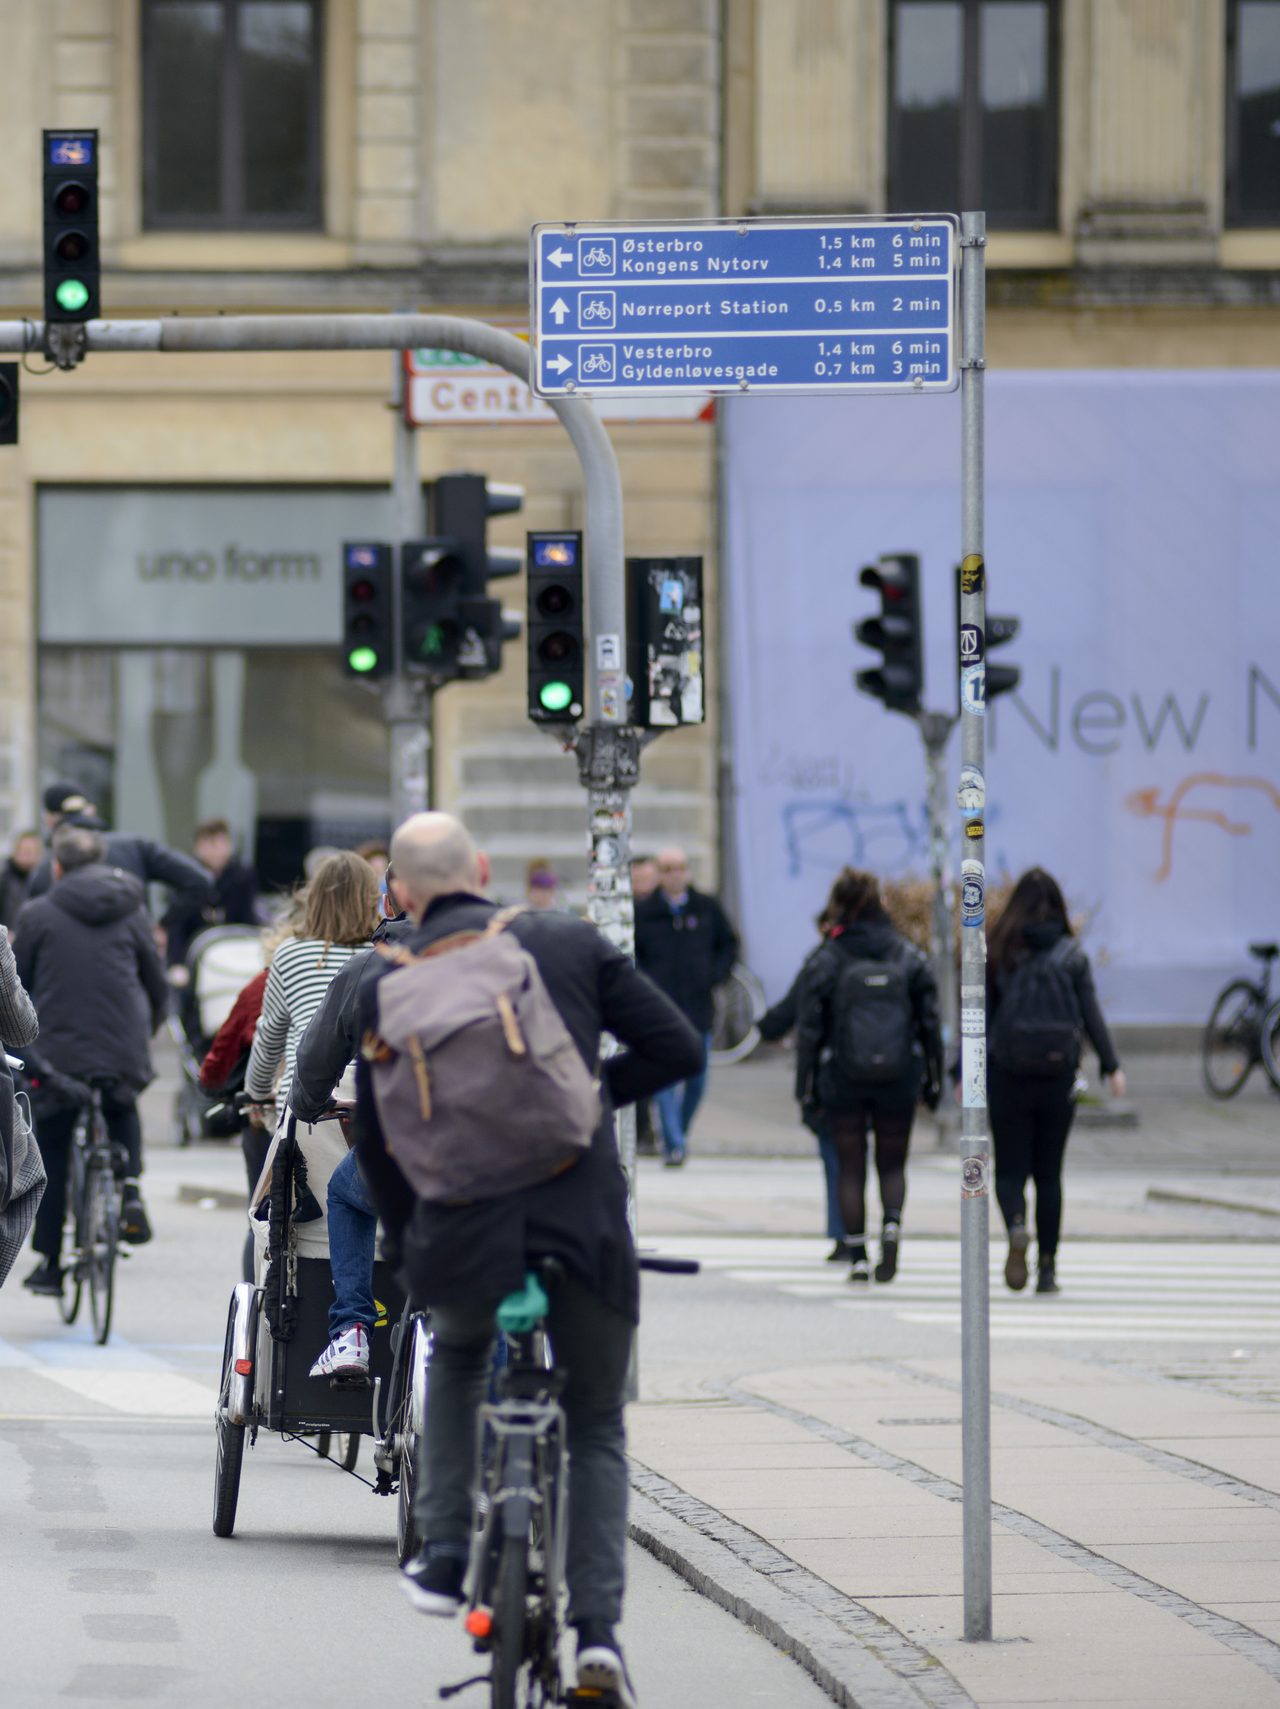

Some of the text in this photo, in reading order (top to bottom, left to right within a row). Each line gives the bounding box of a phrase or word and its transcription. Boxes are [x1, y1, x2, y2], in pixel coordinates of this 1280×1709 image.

[622, 238, 704, 254] Østerbro
[851, 235, 876, 249] km
[891, 233, 903, 248] 6
[909, 233, 941, 248] min
[622, 257, 769, 275] Kongens Nytorv
[851, 254, 876, 268] km
[893, 253, 904, 268] 5
[909, 253, 941, 267] min
[622, 300, 788, 318] Nørreport Station
[850, 298, 875, 312] km
[892, 297, 903, 312] 2
[909, 297, 941, 311] min
[622, 344, 713, 360] Vesterbro
[850, 341, 875, 355] km
[891, 340, 903, 355] 6
[909, 340, 941, 354] min
[621, 362, 778, 382] Gyldenløvesgade
[850, 361, 875, 375] km
[892, 360, 903, 375] 3
[909, 360, 941, 375] min
[137, 543, 321, 582] uno form
[986, 665, 1211, 756] New
